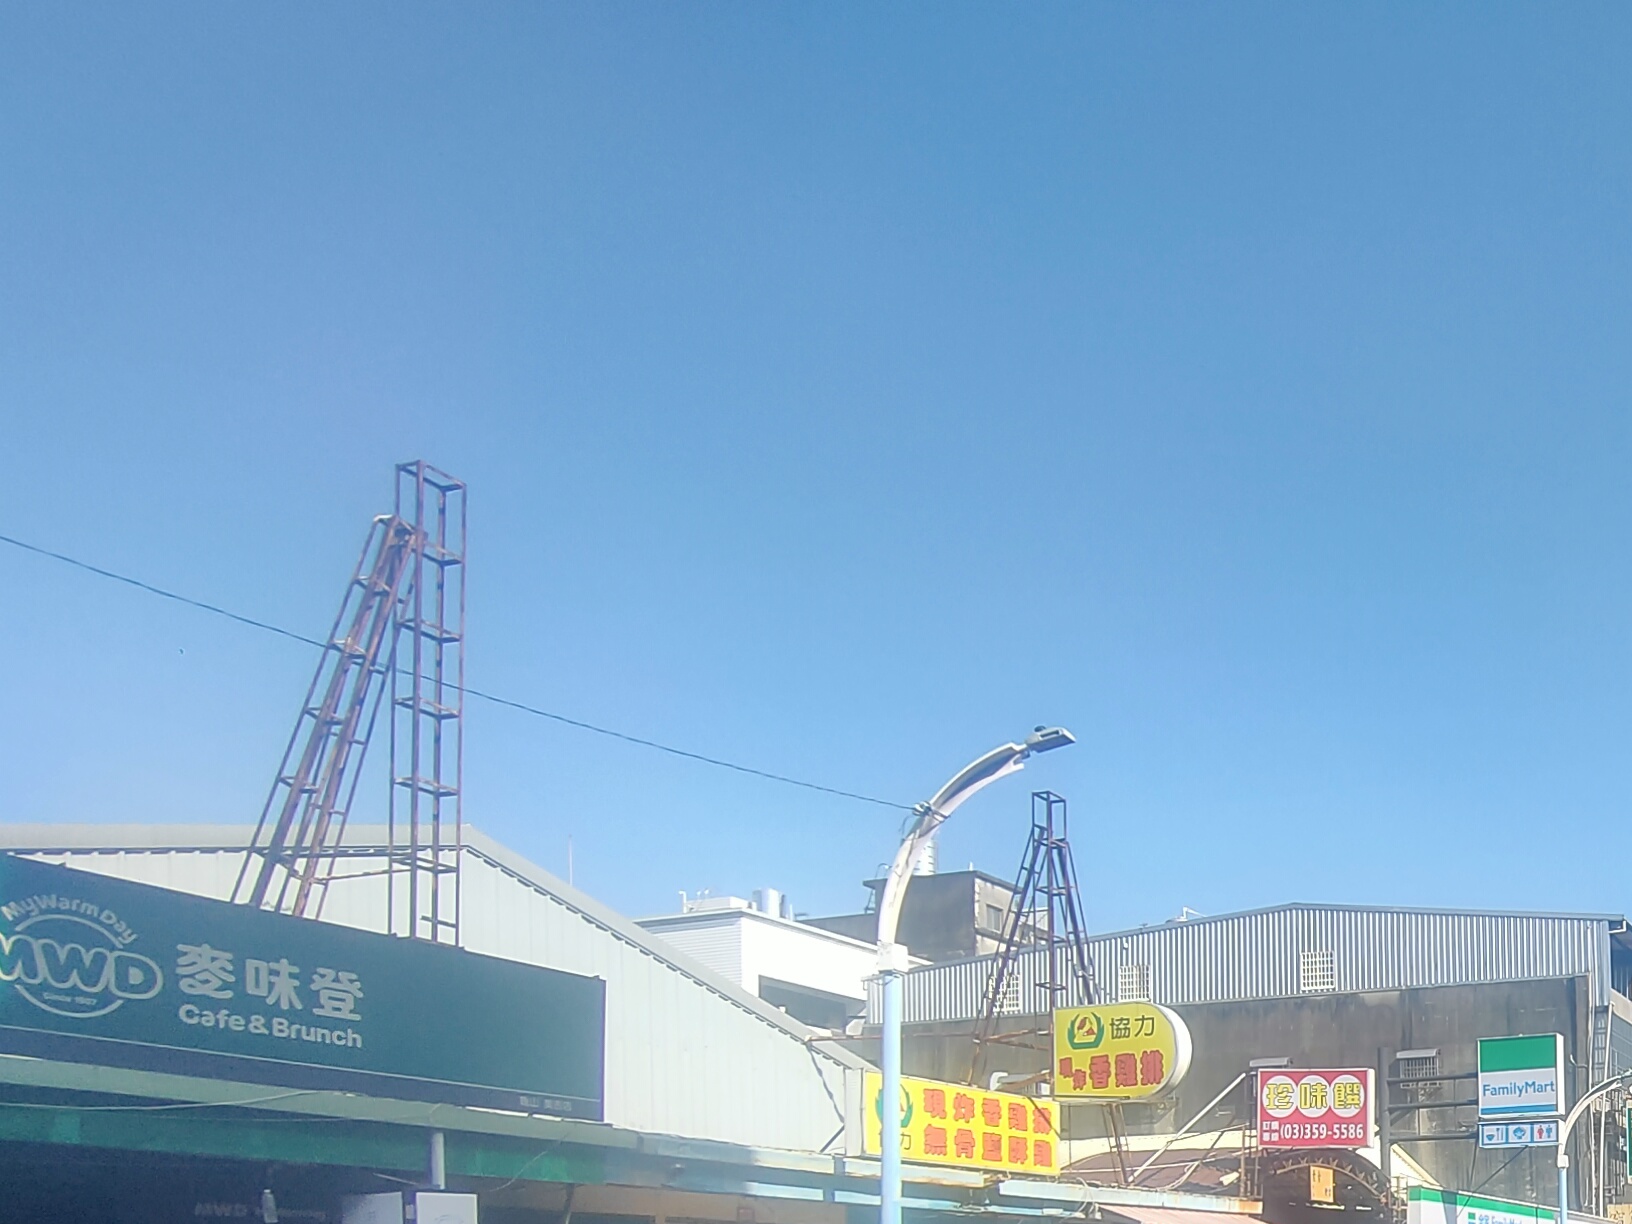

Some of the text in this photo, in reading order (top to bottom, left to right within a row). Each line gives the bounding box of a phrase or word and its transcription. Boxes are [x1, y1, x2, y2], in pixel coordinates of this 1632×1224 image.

[1, 893, 138, 944] MyWarmDay
[0, 933, 163, 999] MWD
[176, 943, 364, 1021] 麥味登
[1109, 1014, 1155, 1040] 協力
[1266, 1083, 1361, 1110] 珍味饌
[1482, 1080, 1556, 1098] FamilyMart
[923, 1088, 1053, 1134] 現炸香雞排
[1280, 1124, 1364, 1140] (03)359-5586
